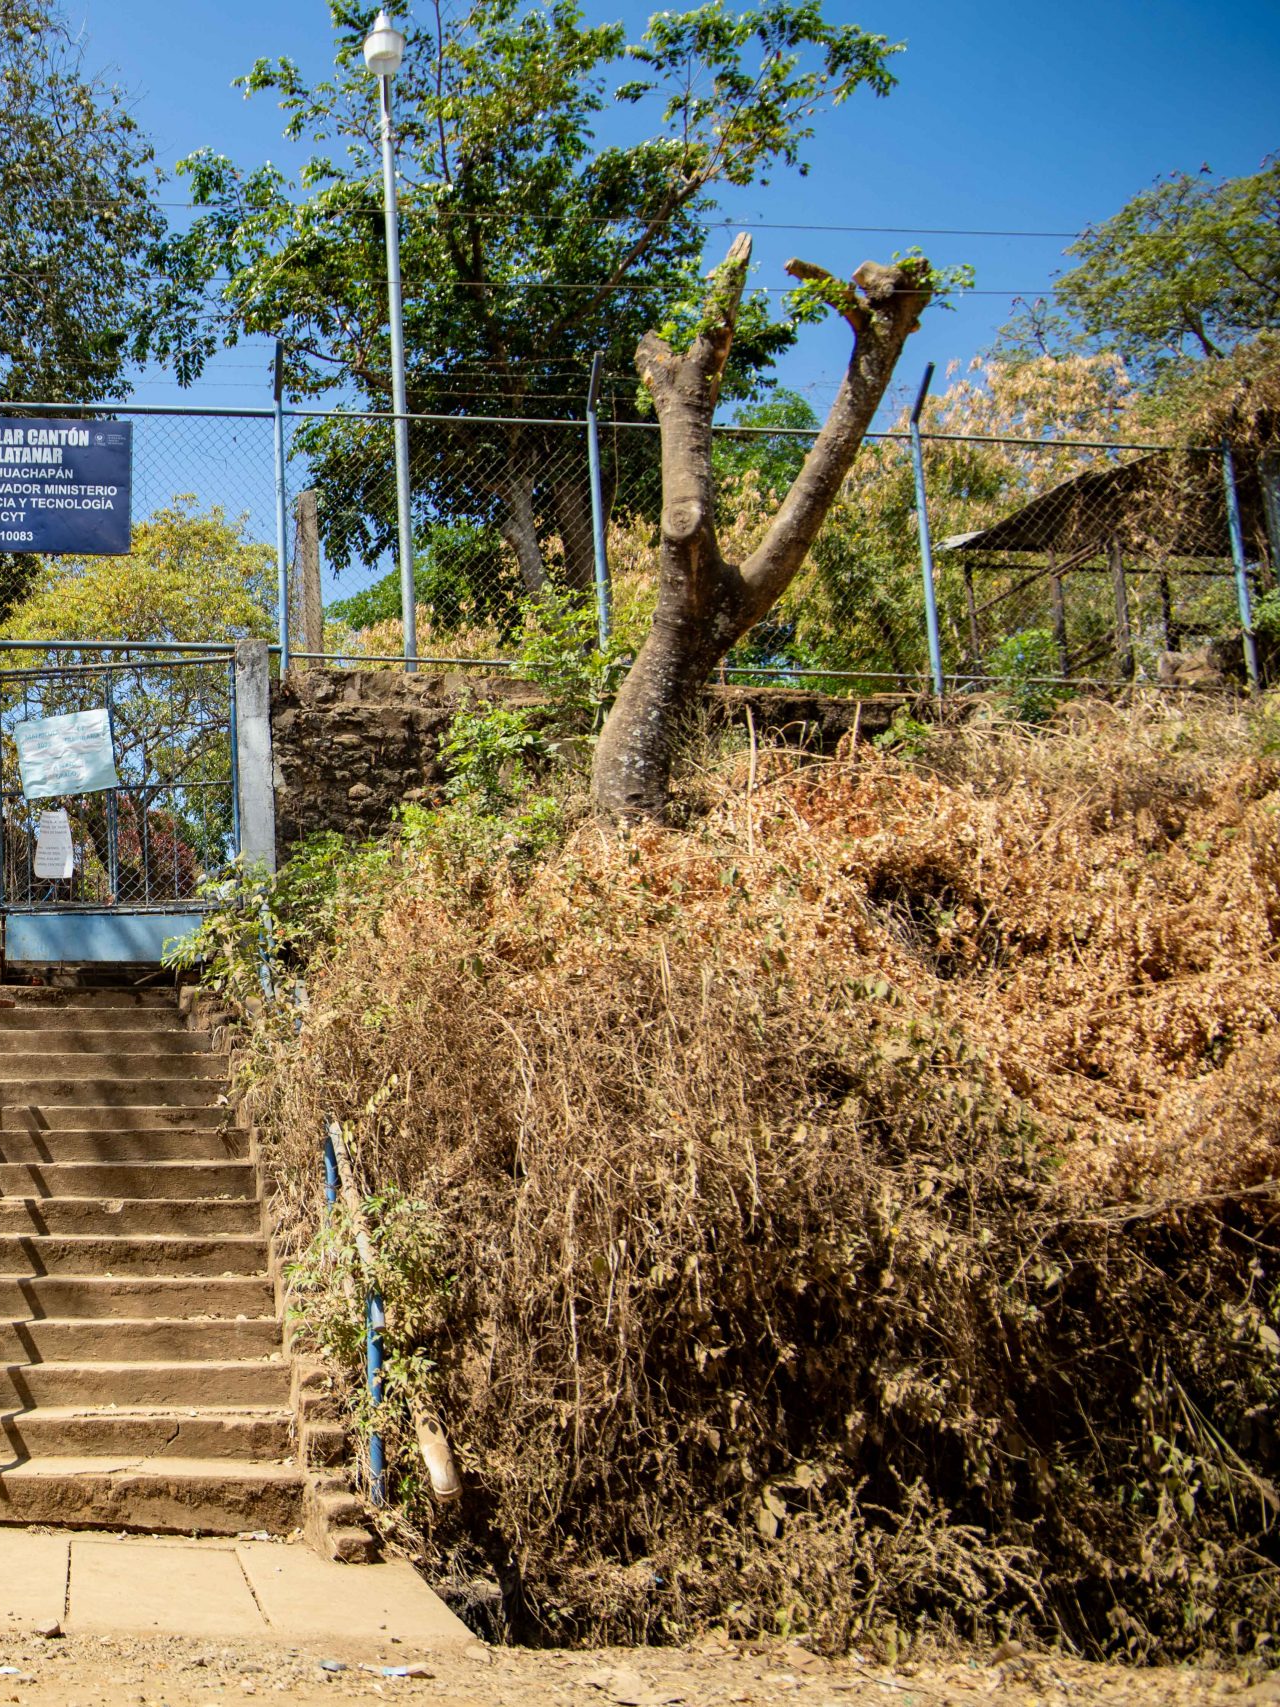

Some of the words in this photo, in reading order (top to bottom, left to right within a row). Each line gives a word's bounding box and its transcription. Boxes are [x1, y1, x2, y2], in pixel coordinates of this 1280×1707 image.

[27, 427, 90, 447] CANTÓN
[44, 484, 118, 496] MINISTERIO
[18, 498, 27, 508] Y
[30, 497, 114, 510] TECNOLOGÍA
[0, 531, 34, 541] 10083
